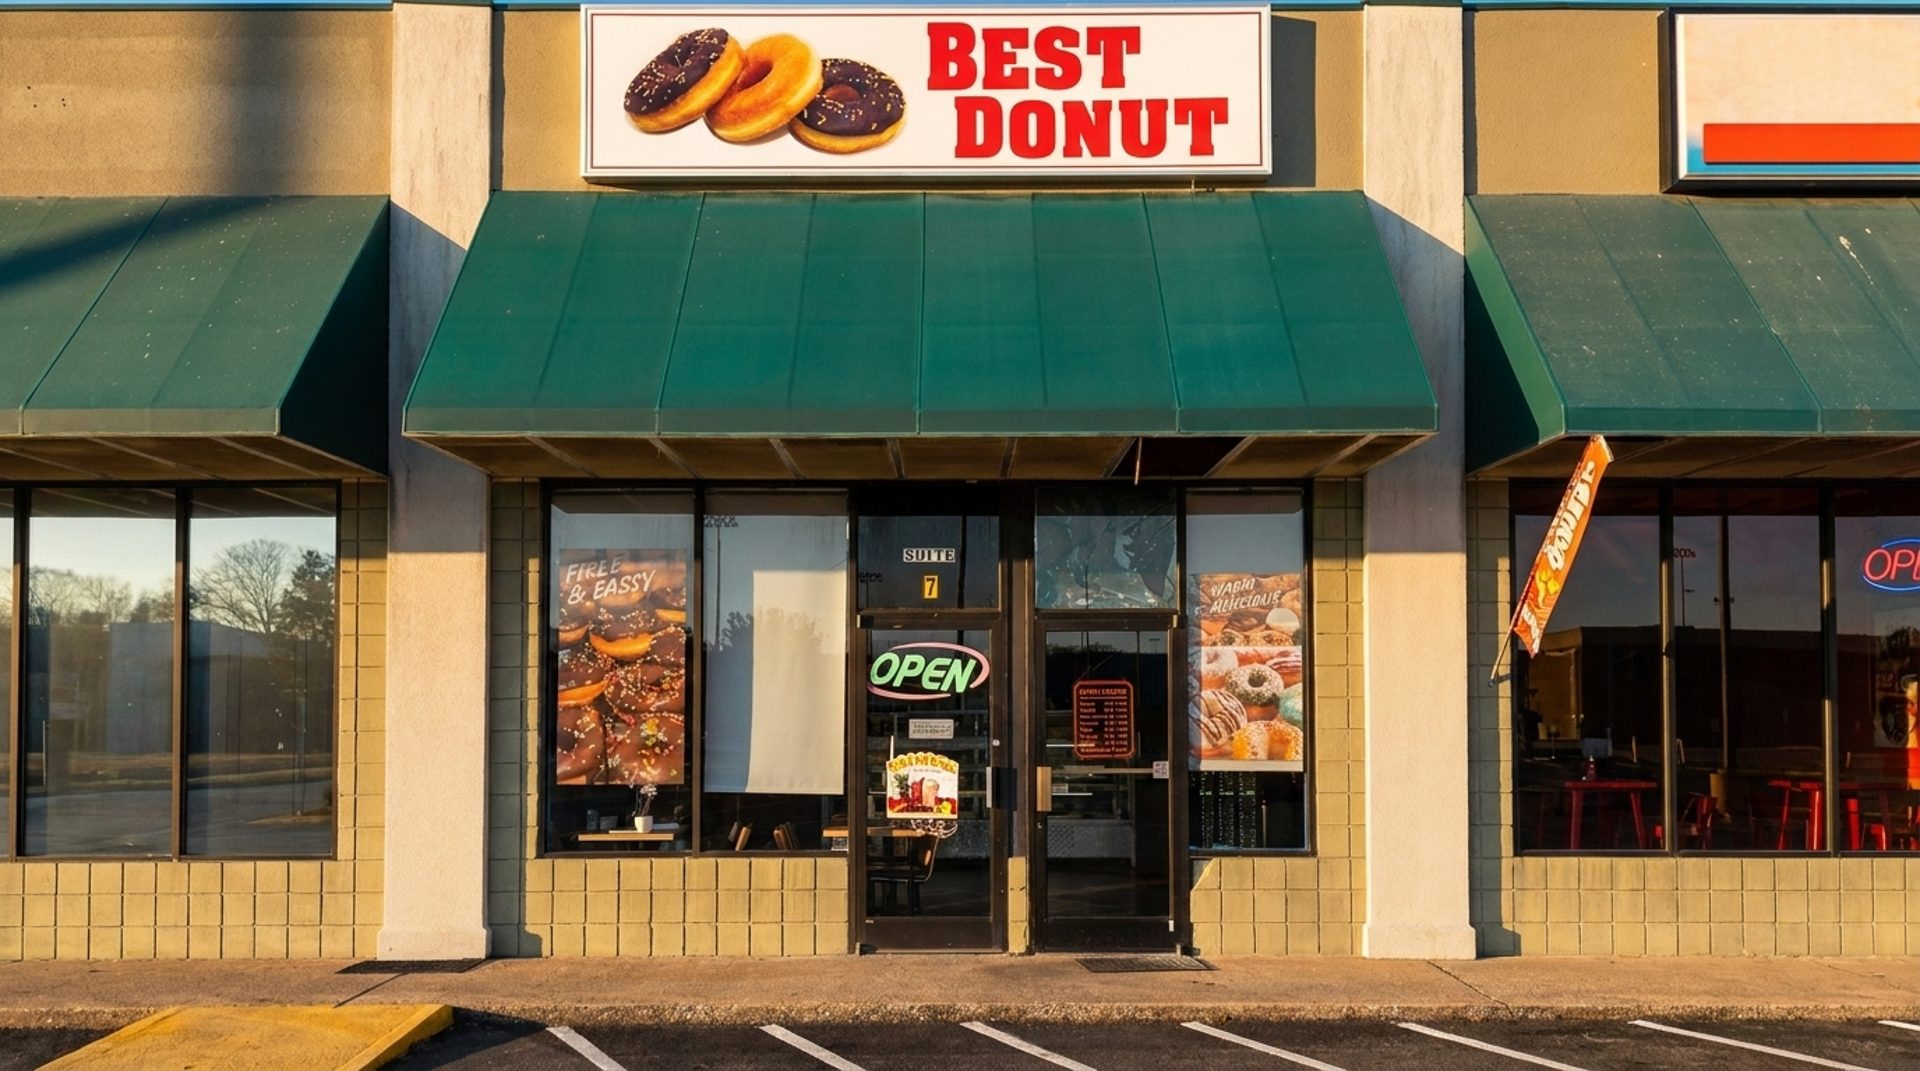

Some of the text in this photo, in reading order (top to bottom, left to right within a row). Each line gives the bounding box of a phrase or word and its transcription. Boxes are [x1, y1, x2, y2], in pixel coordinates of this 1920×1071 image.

[927, 22, 1141, 91] BEST
[954, 96, 1229, 158] DONUT
[904, 549, 954, 562] SUITE
[567, 570, 657, 605] & EASSY
[926, 577, 936, 596] 7
[870, 652, 977, 693] OPEN
